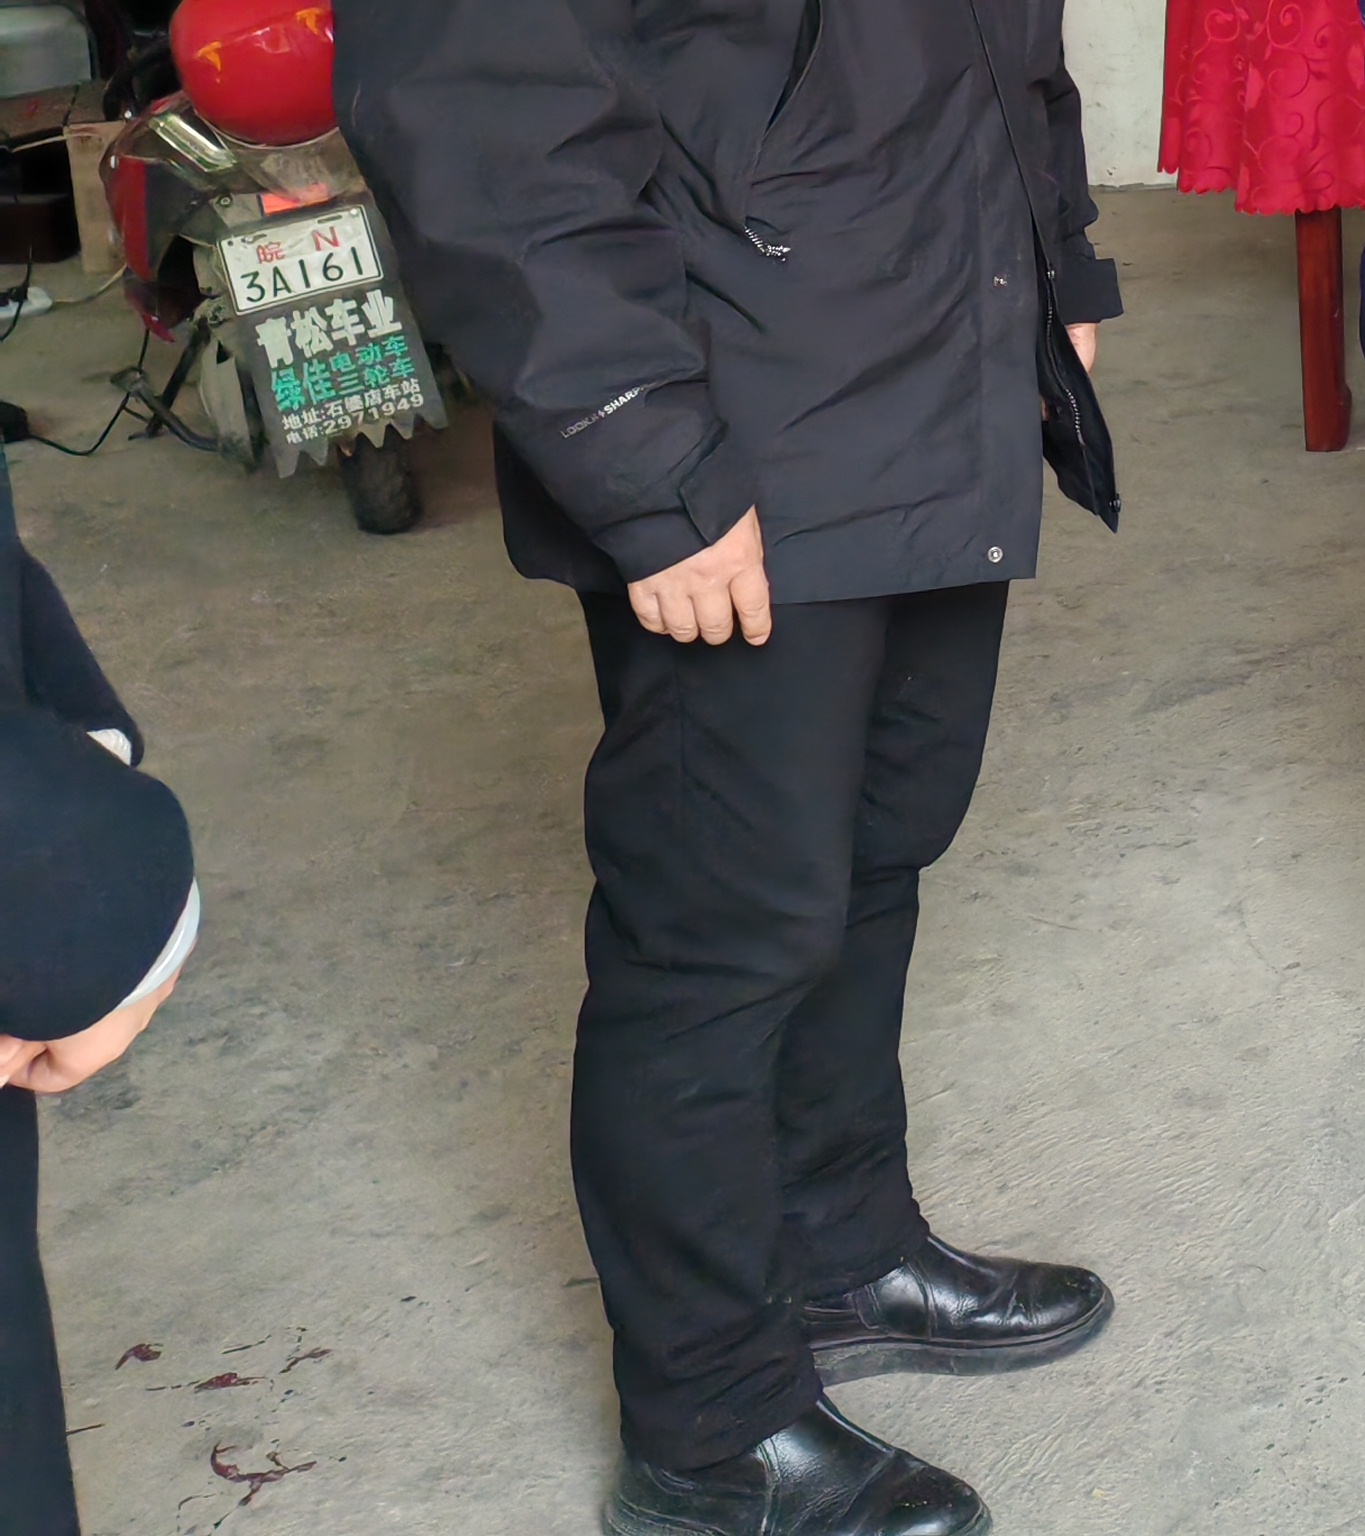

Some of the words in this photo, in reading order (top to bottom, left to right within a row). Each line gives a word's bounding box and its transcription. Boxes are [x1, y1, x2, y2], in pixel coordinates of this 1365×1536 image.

[256, 240, 286, 264] 皖
[312, 226, 340, 251] N
[240, 246, 364, 302] 3A161
[255, 289, 402, 368] 青松车业
[329, 335, 408, 371] 电动车
[338, 356, 415, 397] 三轮车
